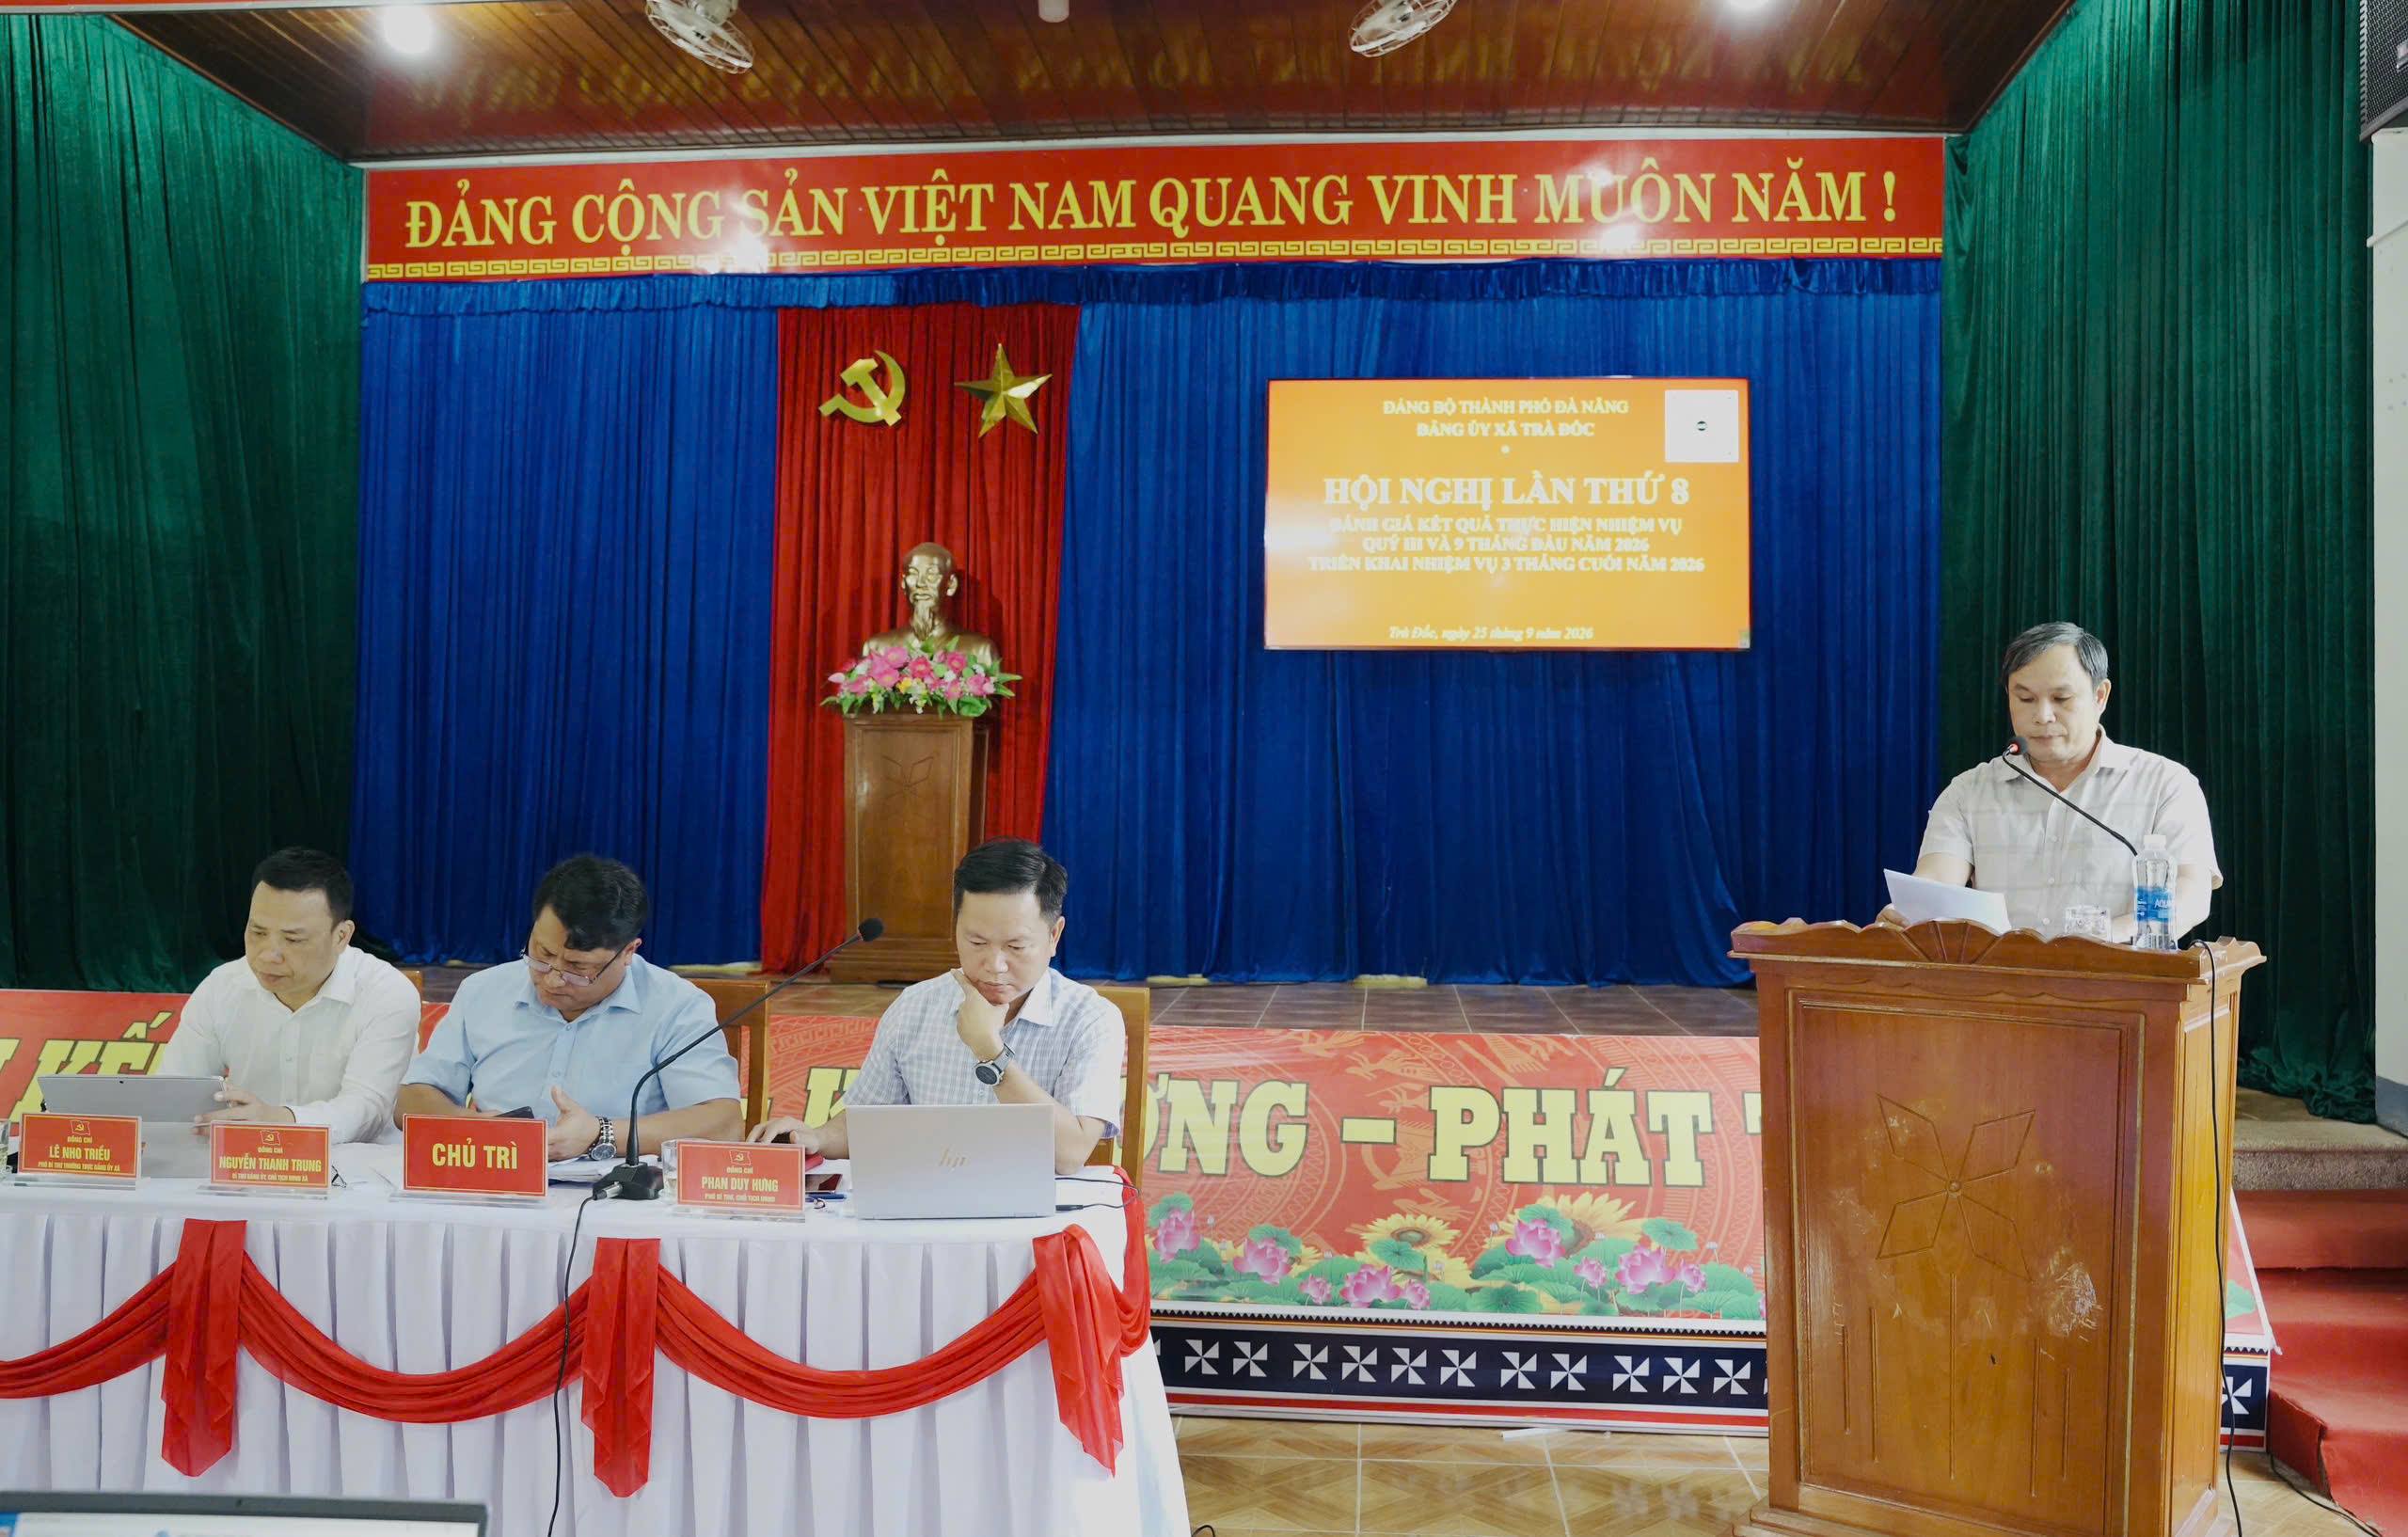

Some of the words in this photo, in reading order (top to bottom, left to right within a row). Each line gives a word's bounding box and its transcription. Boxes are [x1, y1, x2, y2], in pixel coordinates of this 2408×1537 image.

[405, 178, 557, 248] ĐẢNG
[571, 178, 725, 257] CỘNG
[737, 167, 848, 238] SẢN
[861, 167, 994, 246] VIỆT
[1008, 180, 1137, 232] NAM
[1149, 176, 1354, 238] QUANG
[1368, 173, 1519, 226] VINH
[1533, 157, 1716, 224] MUÔN
[1731, 157, 1867, 224] NĂM
[1433, 398, 1456, 416] BỘ
[1458, 397, 1515, 414] THÀNH
[1554, 397, 1578, 414] ĐÀ
[1494, 420, 1518, 436] XÃ
[1521, 420, 1556, 436] TRÀ
[1323, 474, 1392, 512] HỘI
[1400, 477, 1493, 512] NGHỊ
[1501, 470, 1576, 505] LẦN
[1582, 471, 1665, 505] THỨ
[1671, 477, 1690, 505] 8
[1381, 515, 1415, 531] GIÁ
[1658, 517, 1683, 535] VỤ
[1362, 535, 1401, 553] QUÝ
[1427, 535, 1452, 551] VÀ
[1453, 537, 1465, 551] 9
[1365, 556, 1409, 571] KHAI
[1473, 556, 1498, 574] VỤ
[1500, 556, 1512, 572] 3
[1670, 557, 1706, 572] 2026
[1472, 626, 1487, 640] 25
[1526, 626, 1536, 640] 9
[1564, 626, 1594, 640] 2026
[1428, 1067, 1715, 1188] PHÁT
[49, 1144, 60, 1159] LÊ
[62, 1146, 82, 1160] NHO
[431, 1137, 477, 1169] CHỦ
[483, 1141, 518, 1170] TRÌ
[219, 1152, 256, 1170] NGUYỄN
[259, 1158, 289, 1171] THANH
[292, 1158, 322, 1172] TRUNG
[702, 1176, 728, 1190] PHAN
[731, 1177, 750, 1191] DUY
